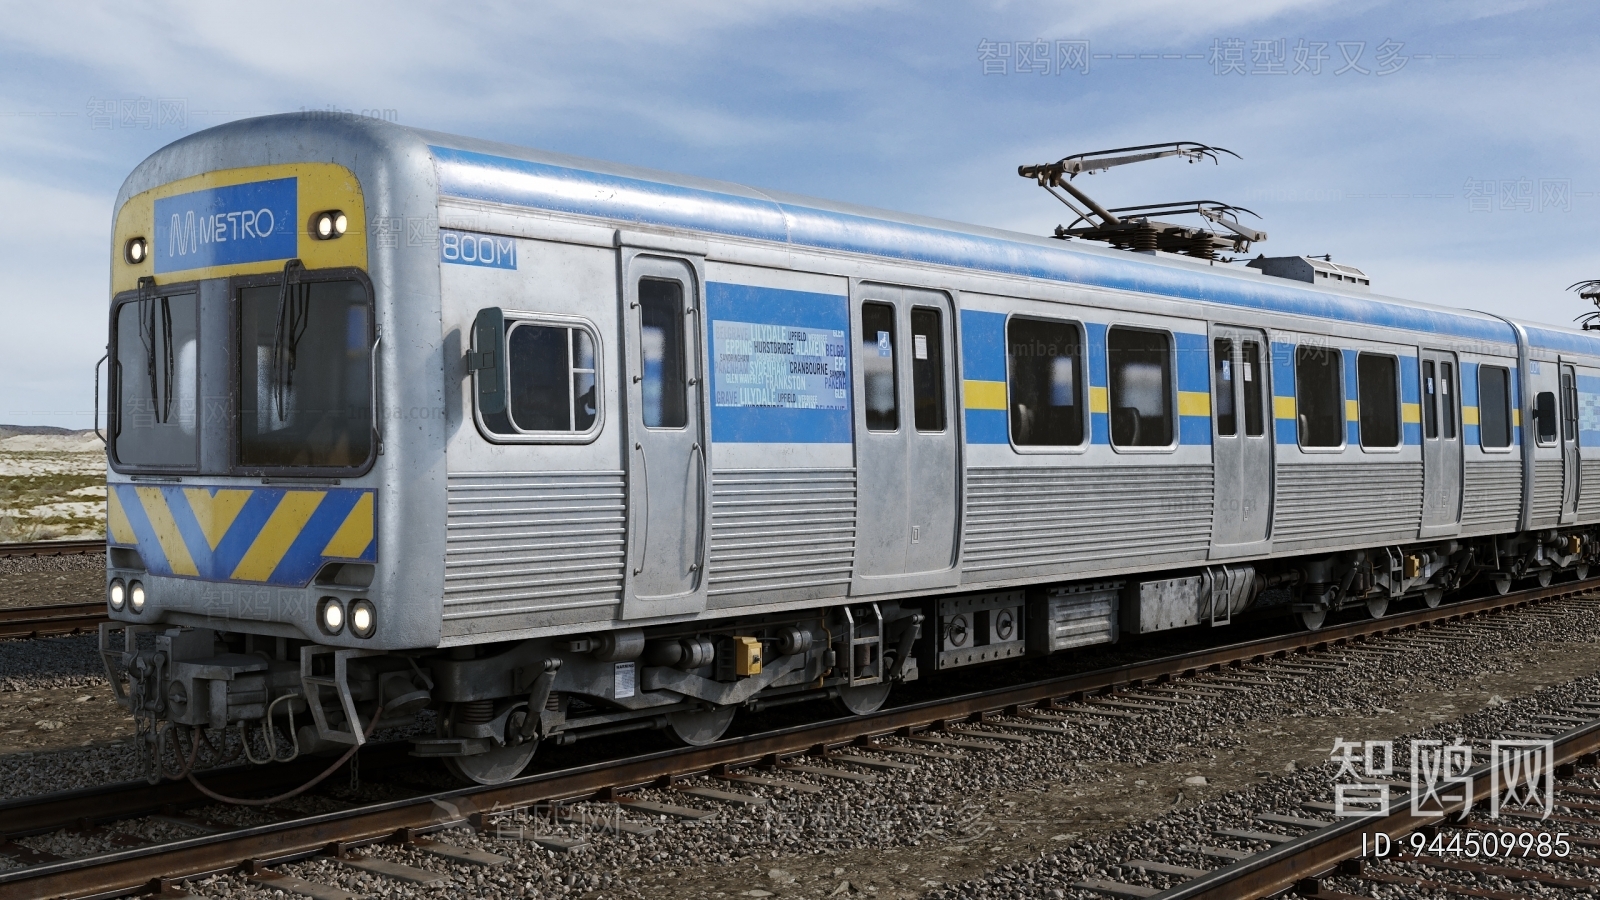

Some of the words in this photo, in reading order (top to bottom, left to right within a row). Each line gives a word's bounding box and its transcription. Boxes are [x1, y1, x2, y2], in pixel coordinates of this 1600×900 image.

[199, 208, 275, 245] METRO
[442, 233, 514, 266] 800M
[750, 324, 786, 342] LILYDALE
[788, 331, 807, 342] UPFIELD
[725, 339, 752, 356] EPPING
[754, 341, 794, 355] HURSTBRIDGE
[795, 341, 826, 357] ALAMEIN
[715, 361, 749, 374] PAKENHAM
[750, 360, 787, 375] SYDENHAM
[790, 361, 828, 375] CRANBOURNE
[726, 373, 739, 384] GLEN
[765, 374, 806, 390] FRANKSTON
[740, 387, 776, 405] LILYDALE
[777, 393, 796, 402] UPFIELD
